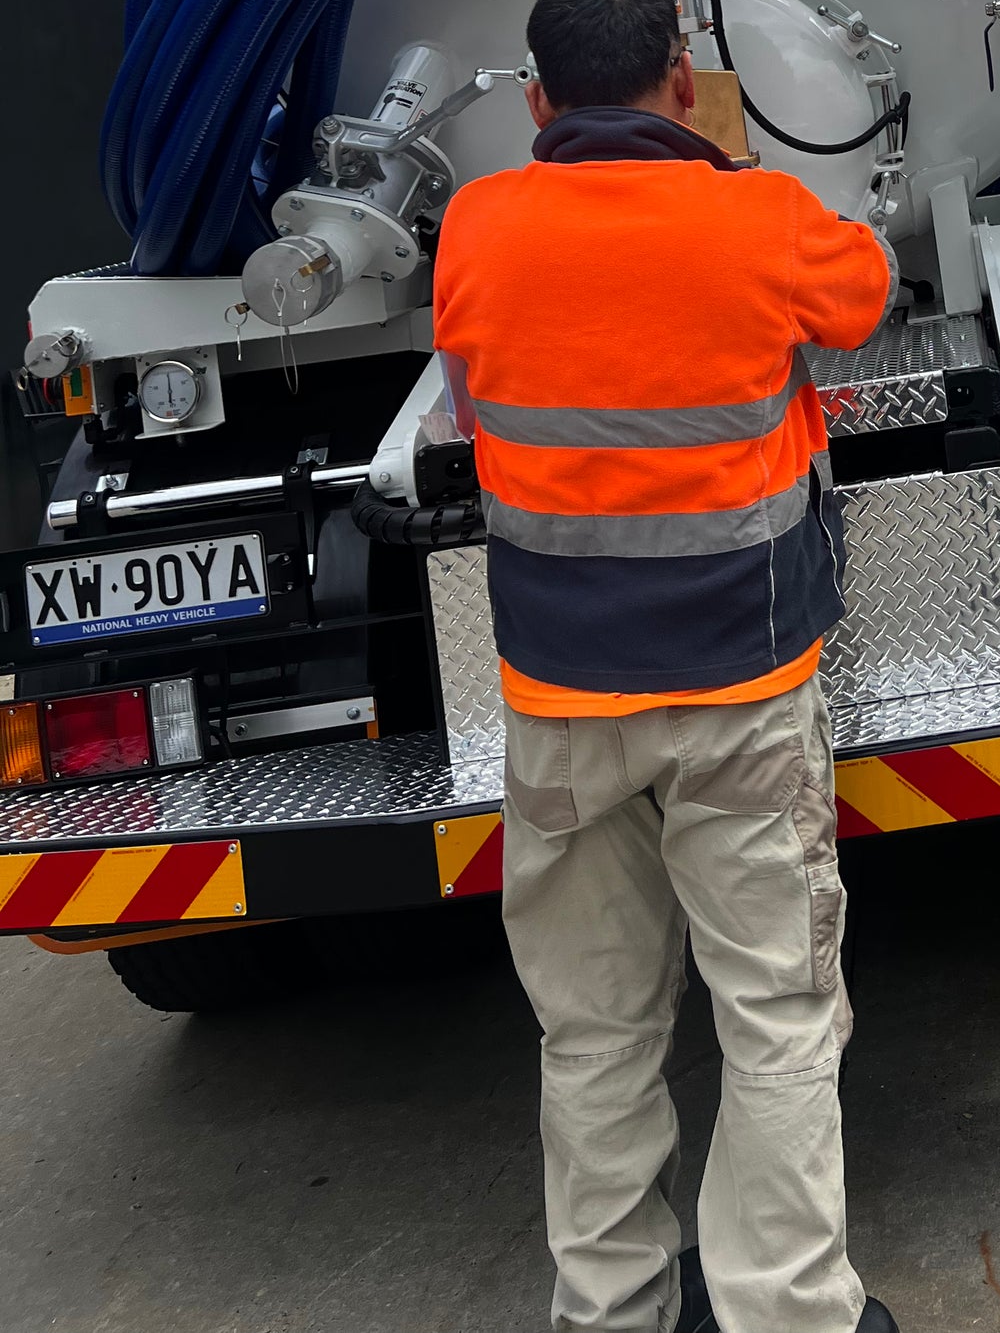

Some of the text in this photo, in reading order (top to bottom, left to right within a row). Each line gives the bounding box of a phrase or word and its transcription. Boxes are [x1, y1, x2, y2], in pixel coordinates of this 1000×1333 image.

[82, 607, 216, 634] NATIONAL HEAVY VEHICLE
